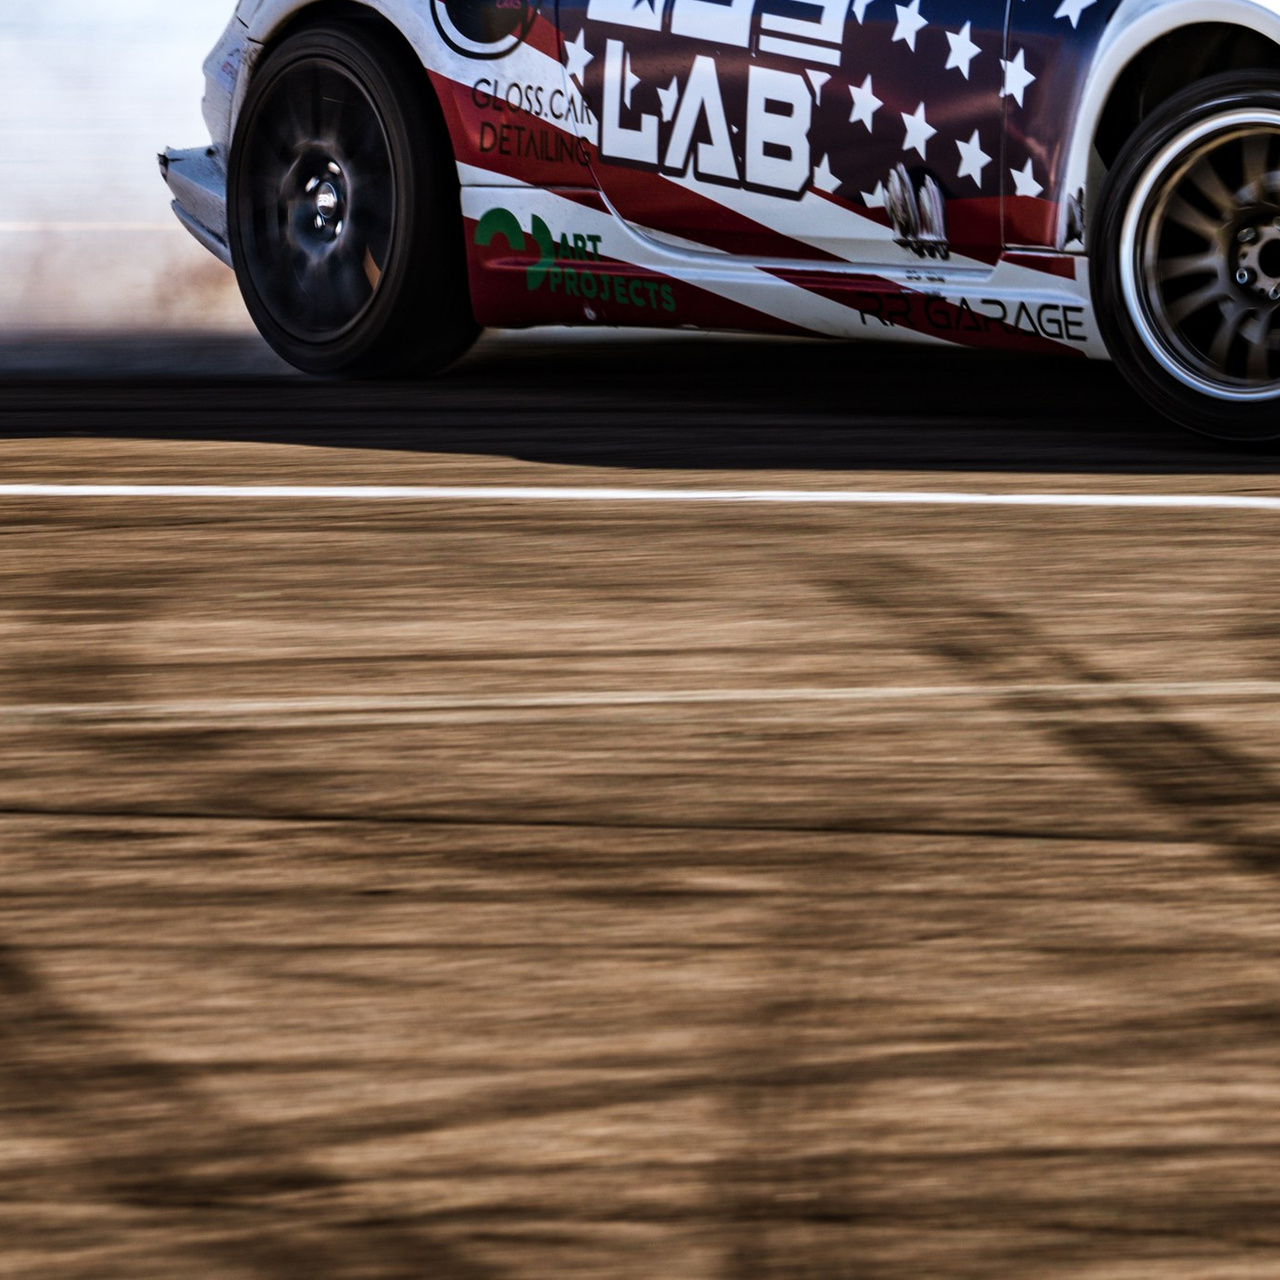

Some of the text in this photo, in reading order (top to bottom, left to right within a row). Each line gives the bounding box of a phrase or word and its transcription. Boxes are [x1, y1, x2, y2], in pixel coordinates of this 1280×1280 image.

[601, 38, 813, 195] LAB
[478, 122, 591, 167] DETAILING
[558, 233, 602, 262] ART
[550, 267, 676, 312] PROJECTS
[924, 295, 1088, 342] GARAGE
